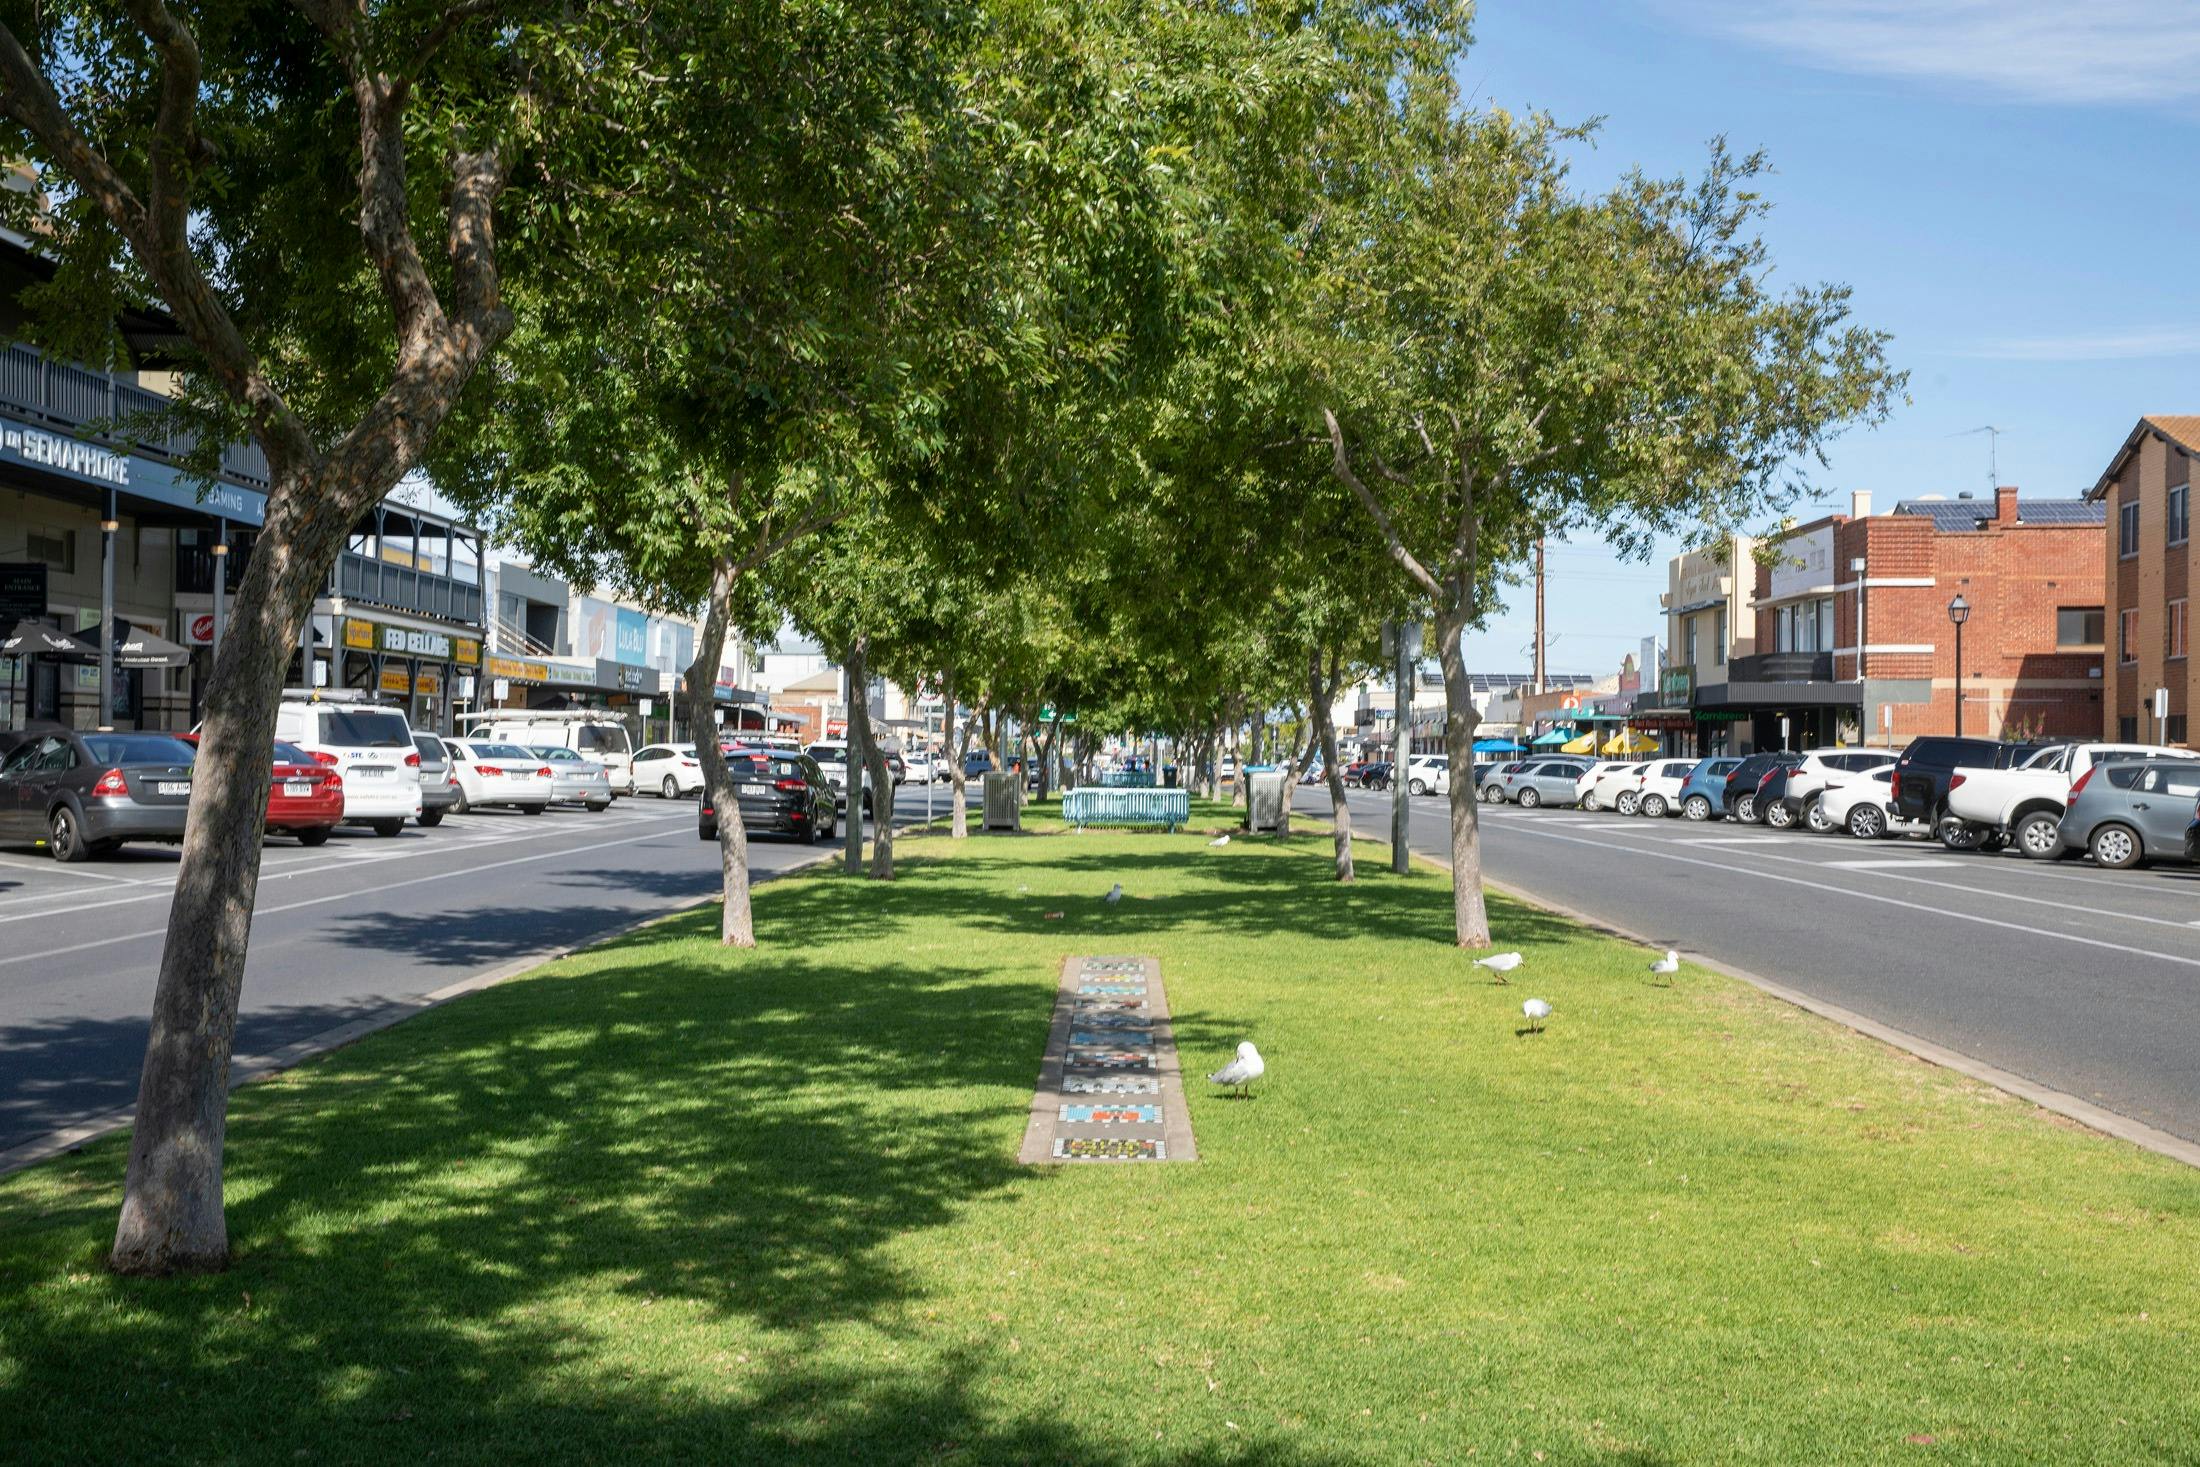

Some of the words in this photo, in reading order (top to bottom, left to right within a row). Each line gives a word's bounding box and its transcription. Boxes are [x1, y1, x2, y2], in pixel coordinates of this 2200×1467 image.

[23, 429, 129, 485] SEMAPHORE
[208, 487, 242, 512] GAMING
[385, 628, 406, 651] FED
[407, 631, 450, 658] CELLARS
[1695, 711, 1746, 721] Zambrero
